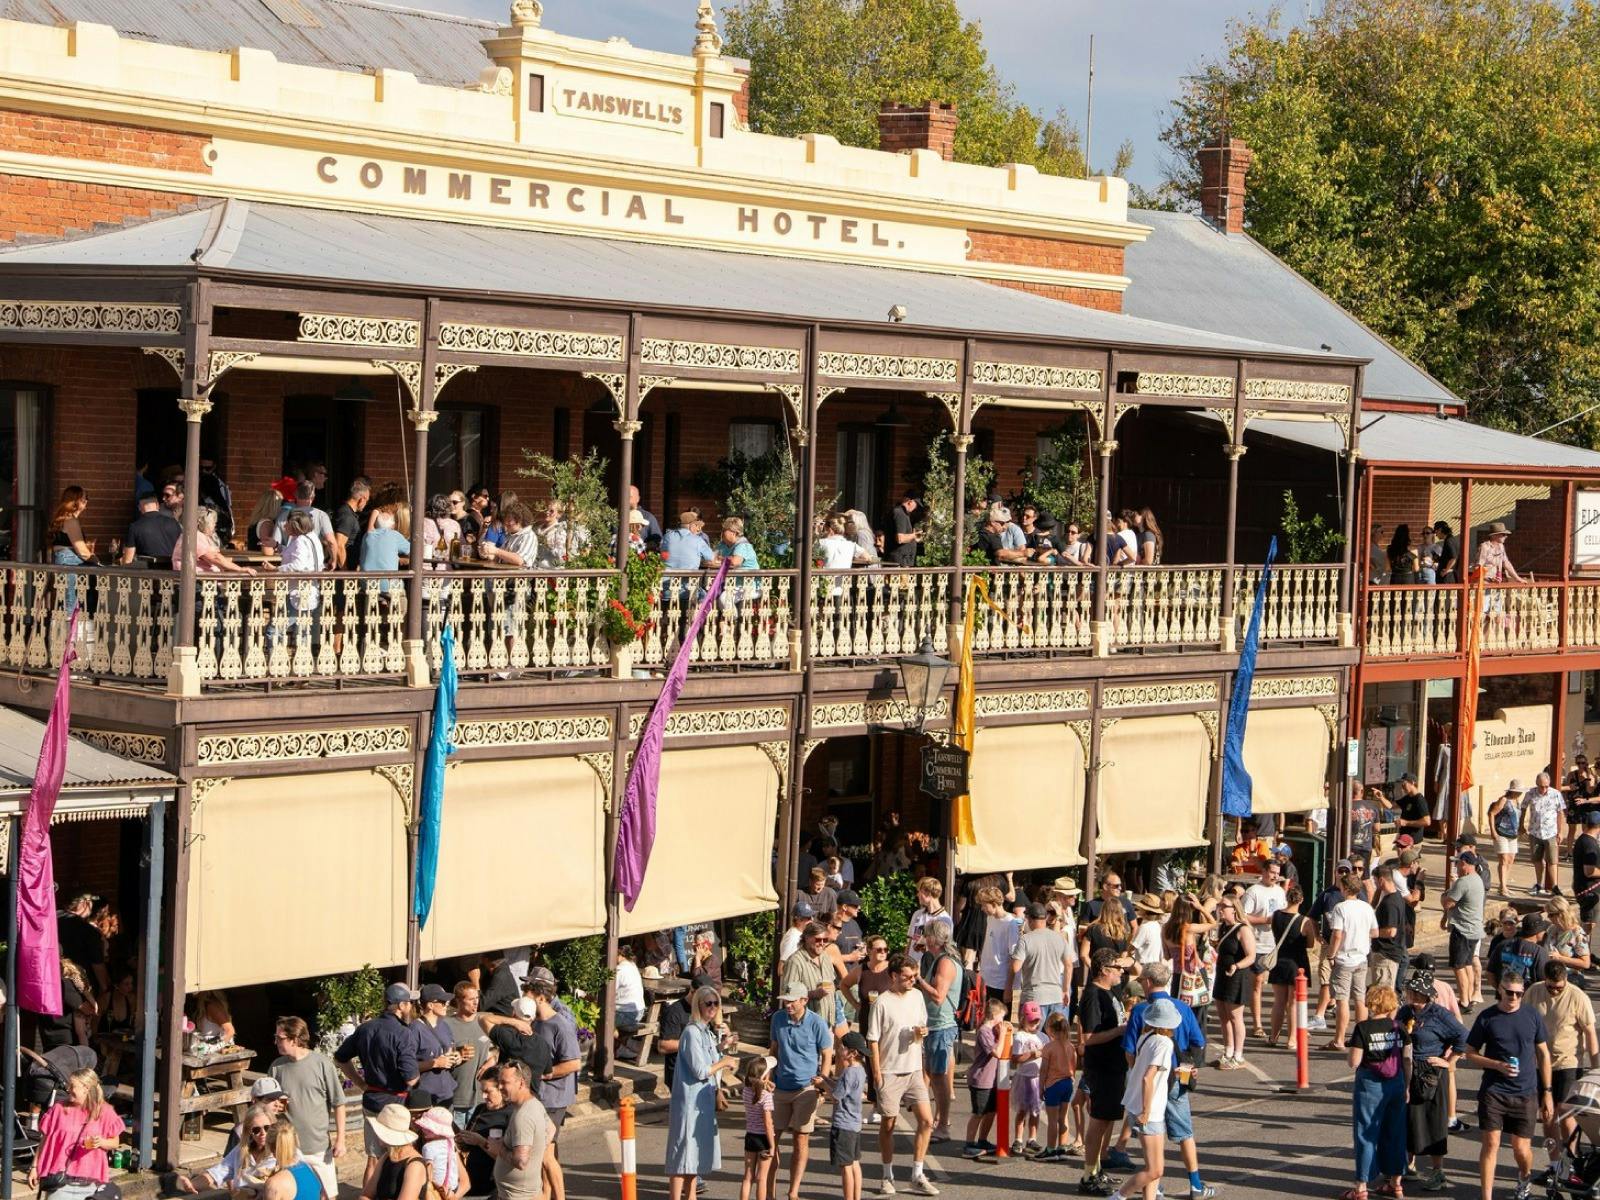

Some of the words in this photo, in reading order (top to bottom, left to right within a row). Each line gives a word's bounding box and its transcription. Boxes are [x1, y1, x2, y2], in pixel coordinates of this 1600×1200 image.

[563, 88, 683, 125] TANSWELL'S
[316, 155, 684, 225] COMMERCIAL
[738, 206, 905, 249] HOTEL.
[1483, 731, 1516, 746] Eldorado
[1517, 727, 1536, 744] Road
[926, 761, 962, 776] COMMERCIAL
